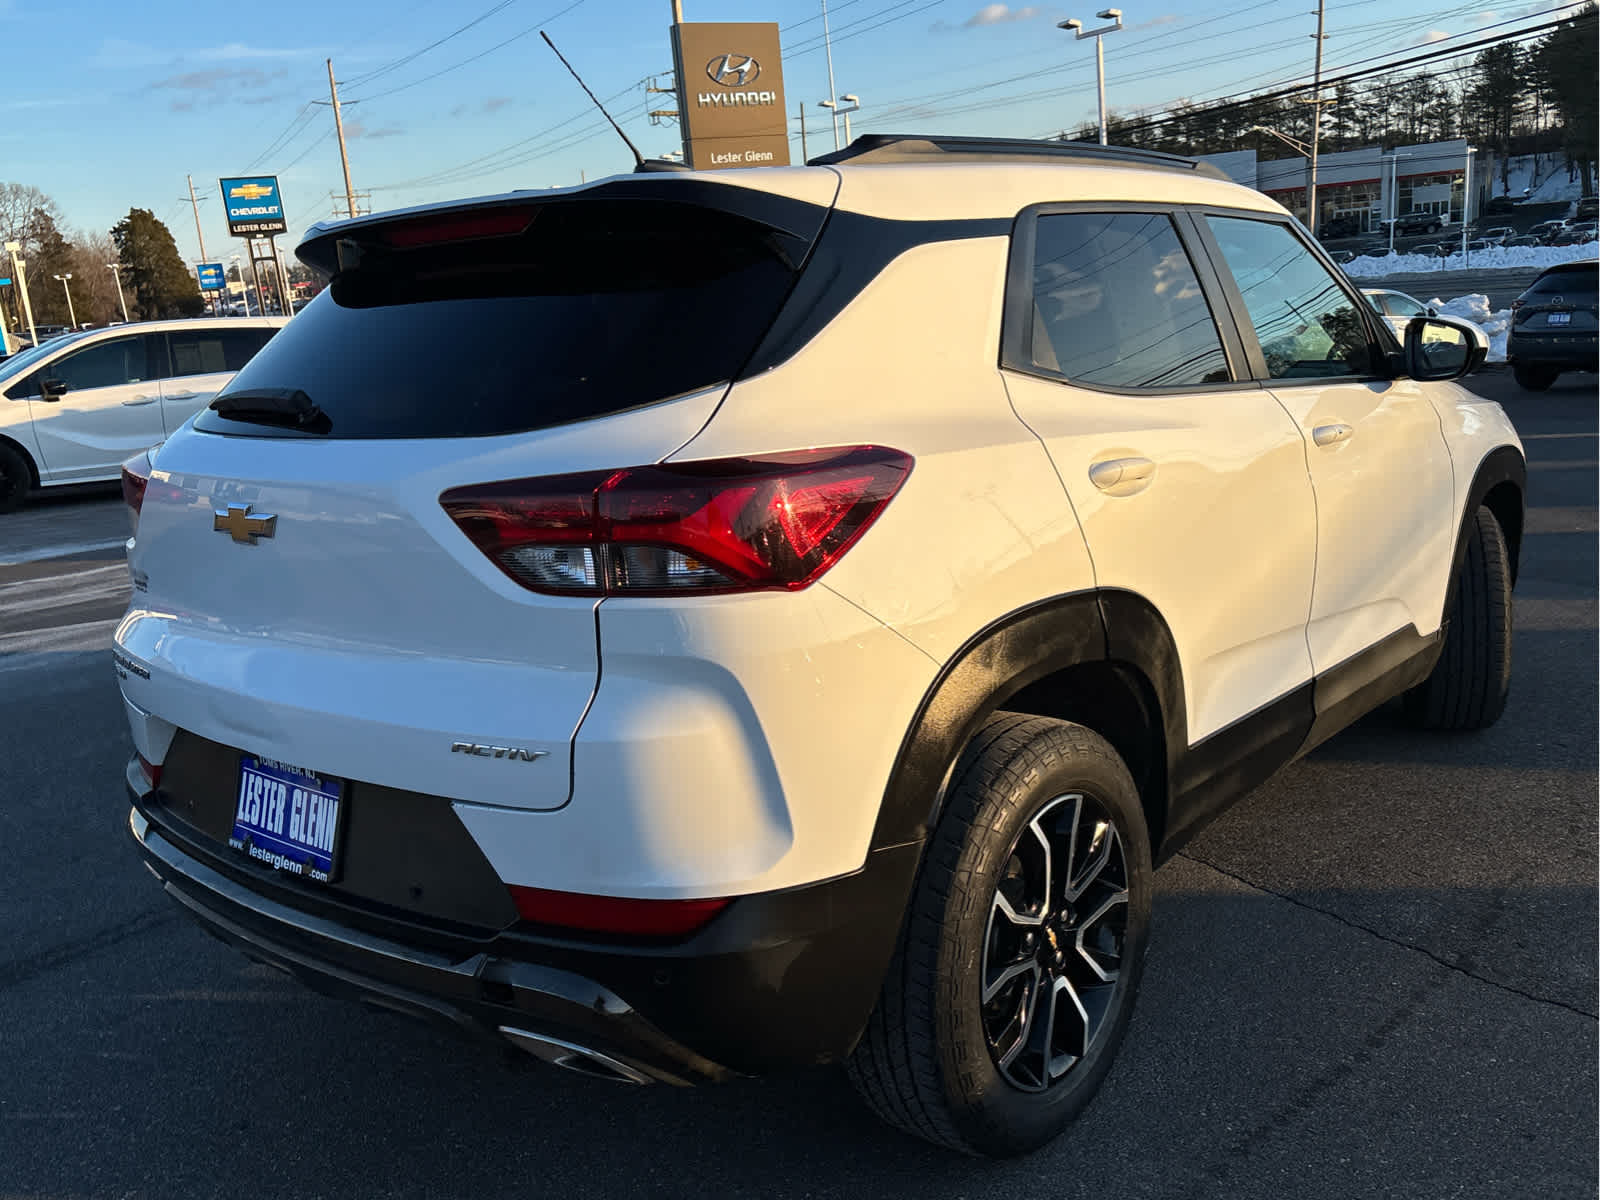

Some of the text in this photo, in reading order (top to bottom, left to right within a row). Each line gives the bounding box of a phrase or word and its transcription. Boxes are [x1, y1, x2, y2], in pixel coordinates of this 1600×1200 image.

[698, 91, 776, 107] HYUNDAI
[711, 151, 773, 164] Lester Glenn
[230, 206, 279, 216] CHEVROLET
[233, 223, 283, 232] LESTER GLENN
[451, 742, 551, 762] ACTIV
[237, 771, 339, 853] LESTER GLENN
